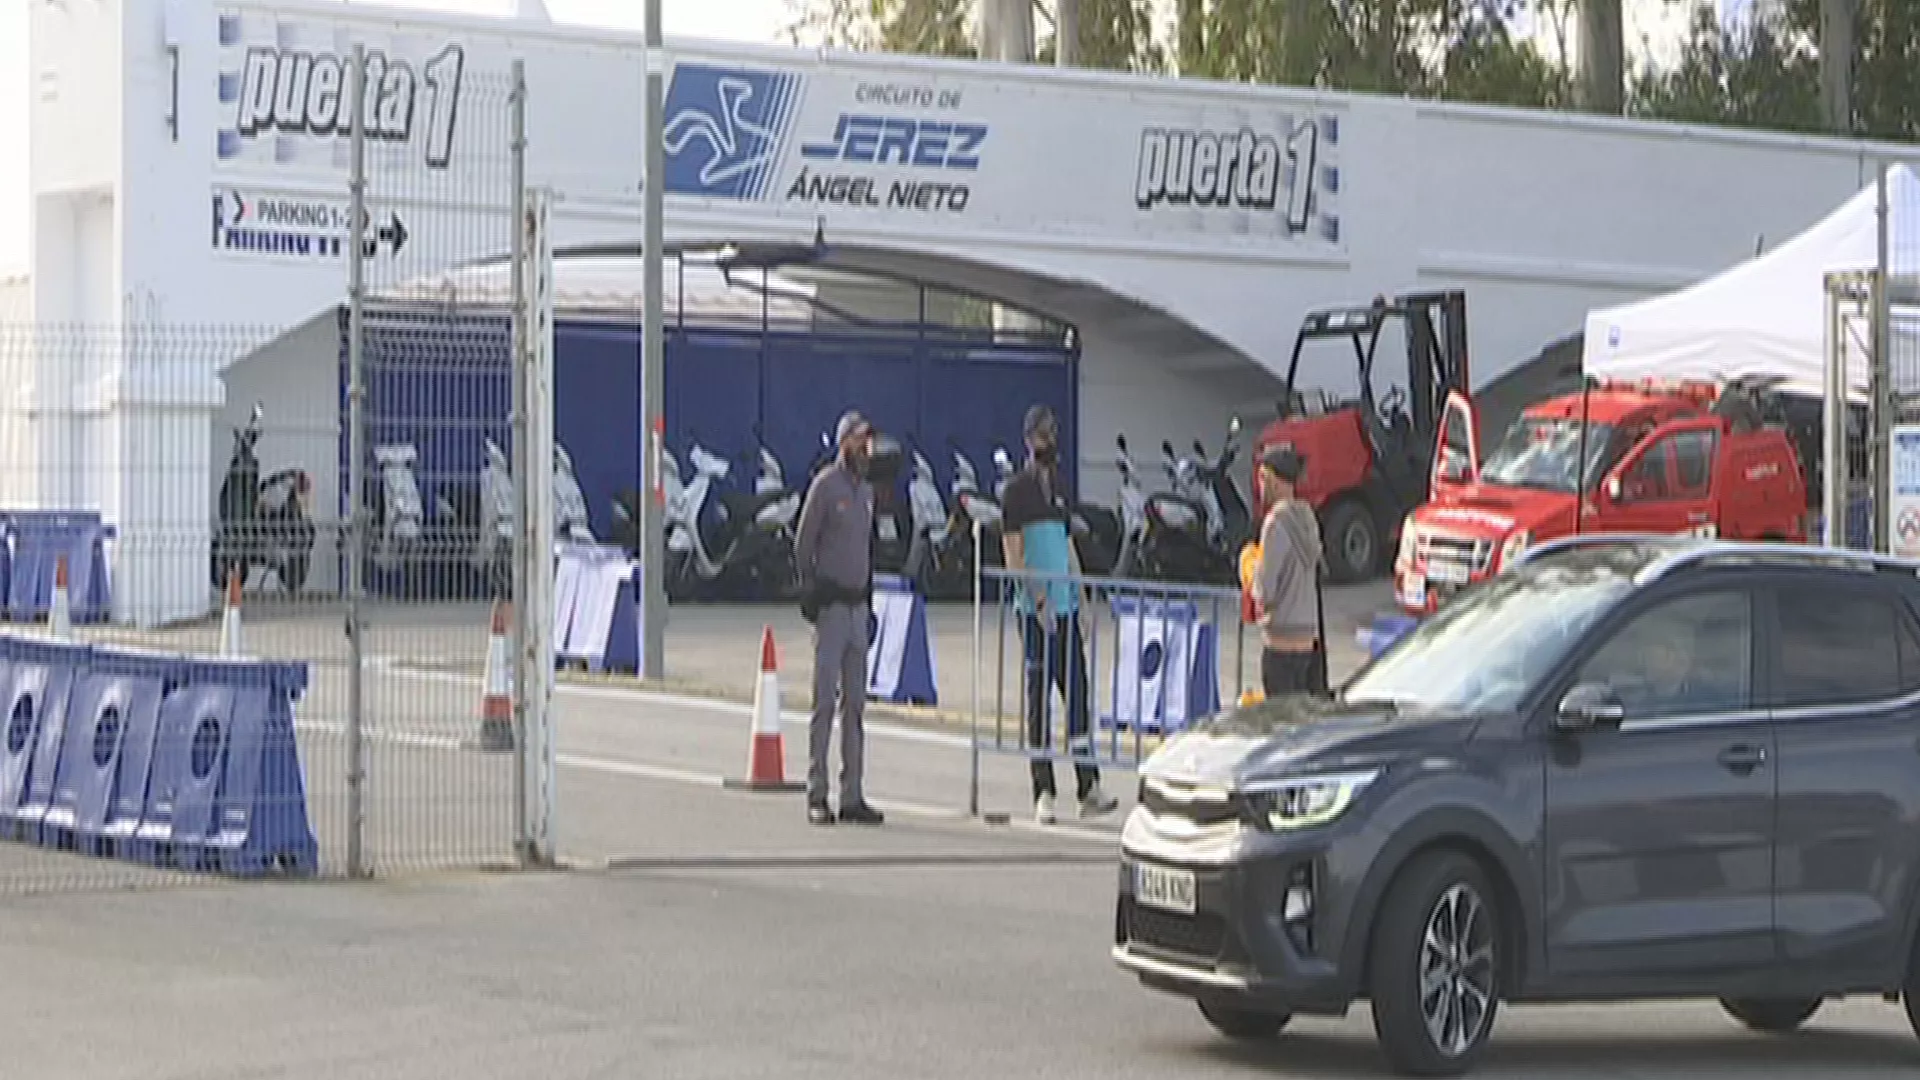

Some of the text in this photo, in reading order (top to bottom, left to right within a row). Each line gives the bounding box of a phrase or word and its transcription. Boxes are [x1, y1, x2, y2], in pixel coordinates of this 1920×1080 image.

[427, 44, 463, 169] 1
[855, 82, 961, 110] CIRCUITO DE
[801, 114, 988, 171] JEREZ
[786, 165, 970, 212] ÁNGEL NIETO
[1136, 119, 1317, 233] puerta 1
[257, 200, 329, 228] PARKING
